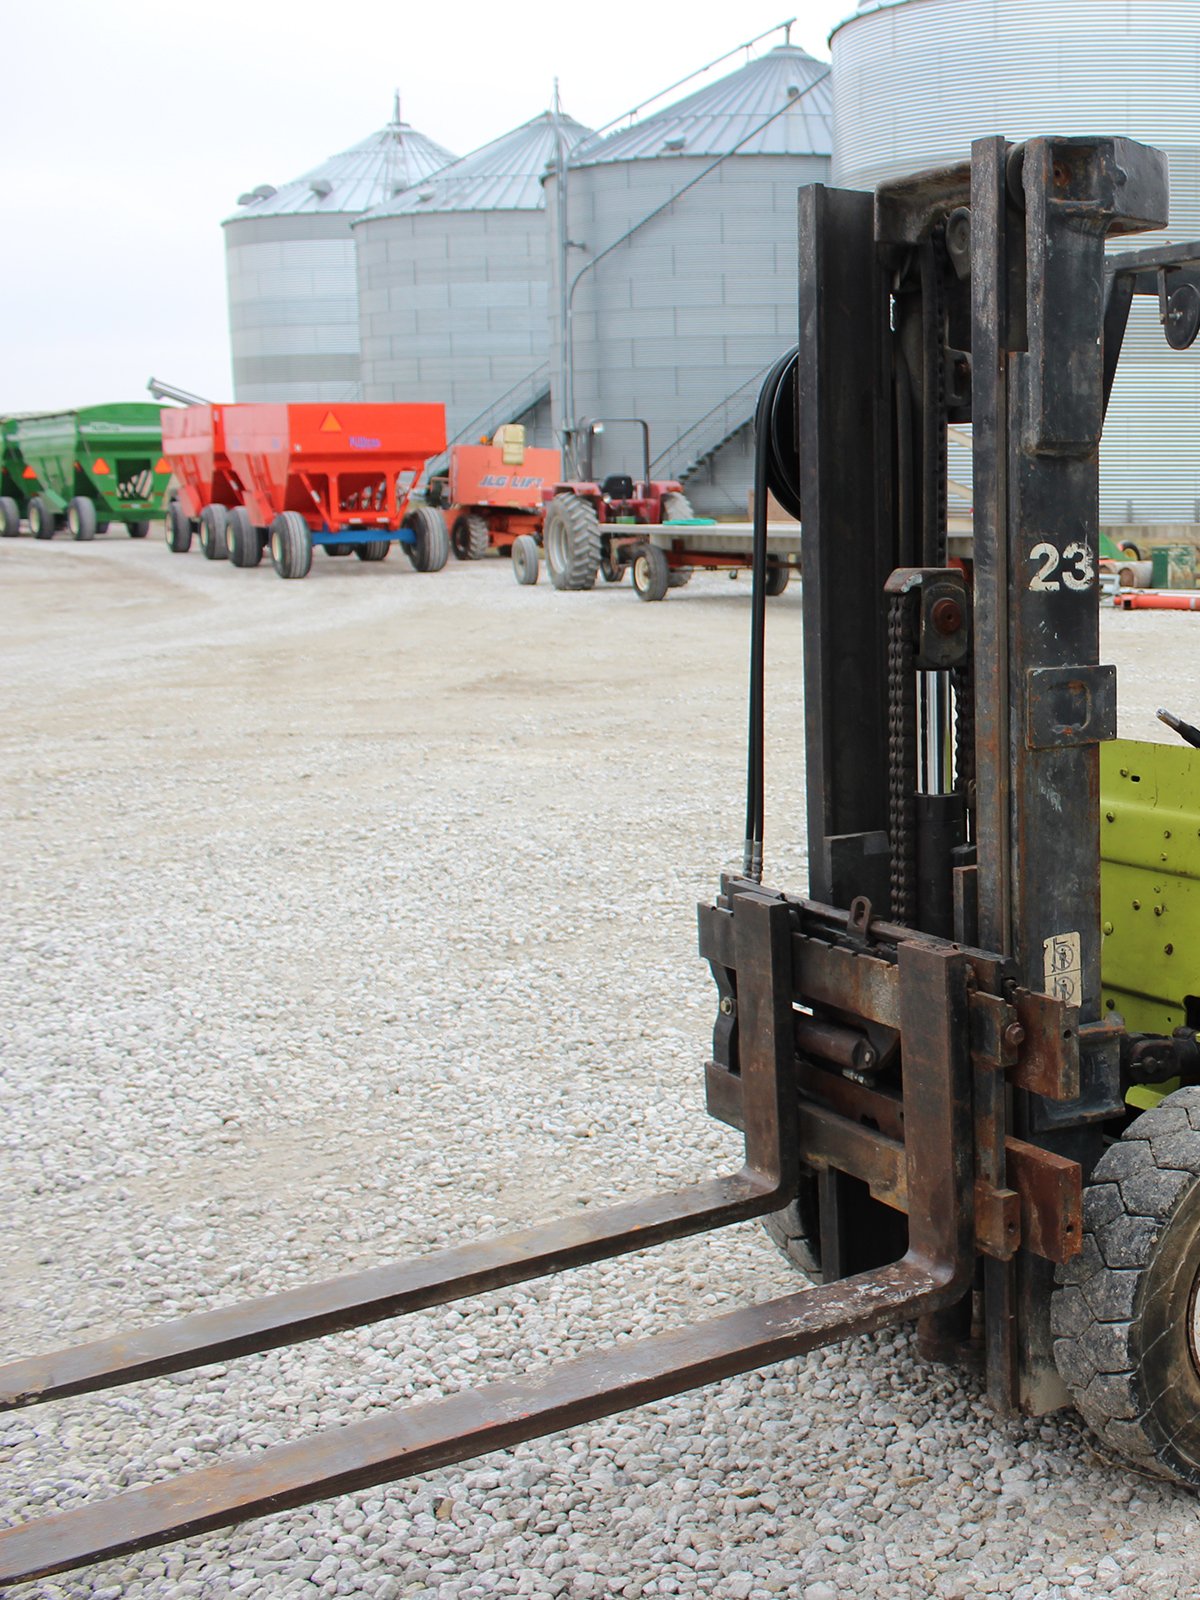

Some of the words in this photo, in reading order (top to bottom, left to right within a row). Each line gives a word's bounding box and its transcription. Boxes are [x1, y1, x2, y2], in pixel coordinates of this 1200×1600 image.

[479, 475, 507, 487] JLG
[510, 477, 543, 489] LIFT
[1029, 542, 1094, 591] 23
